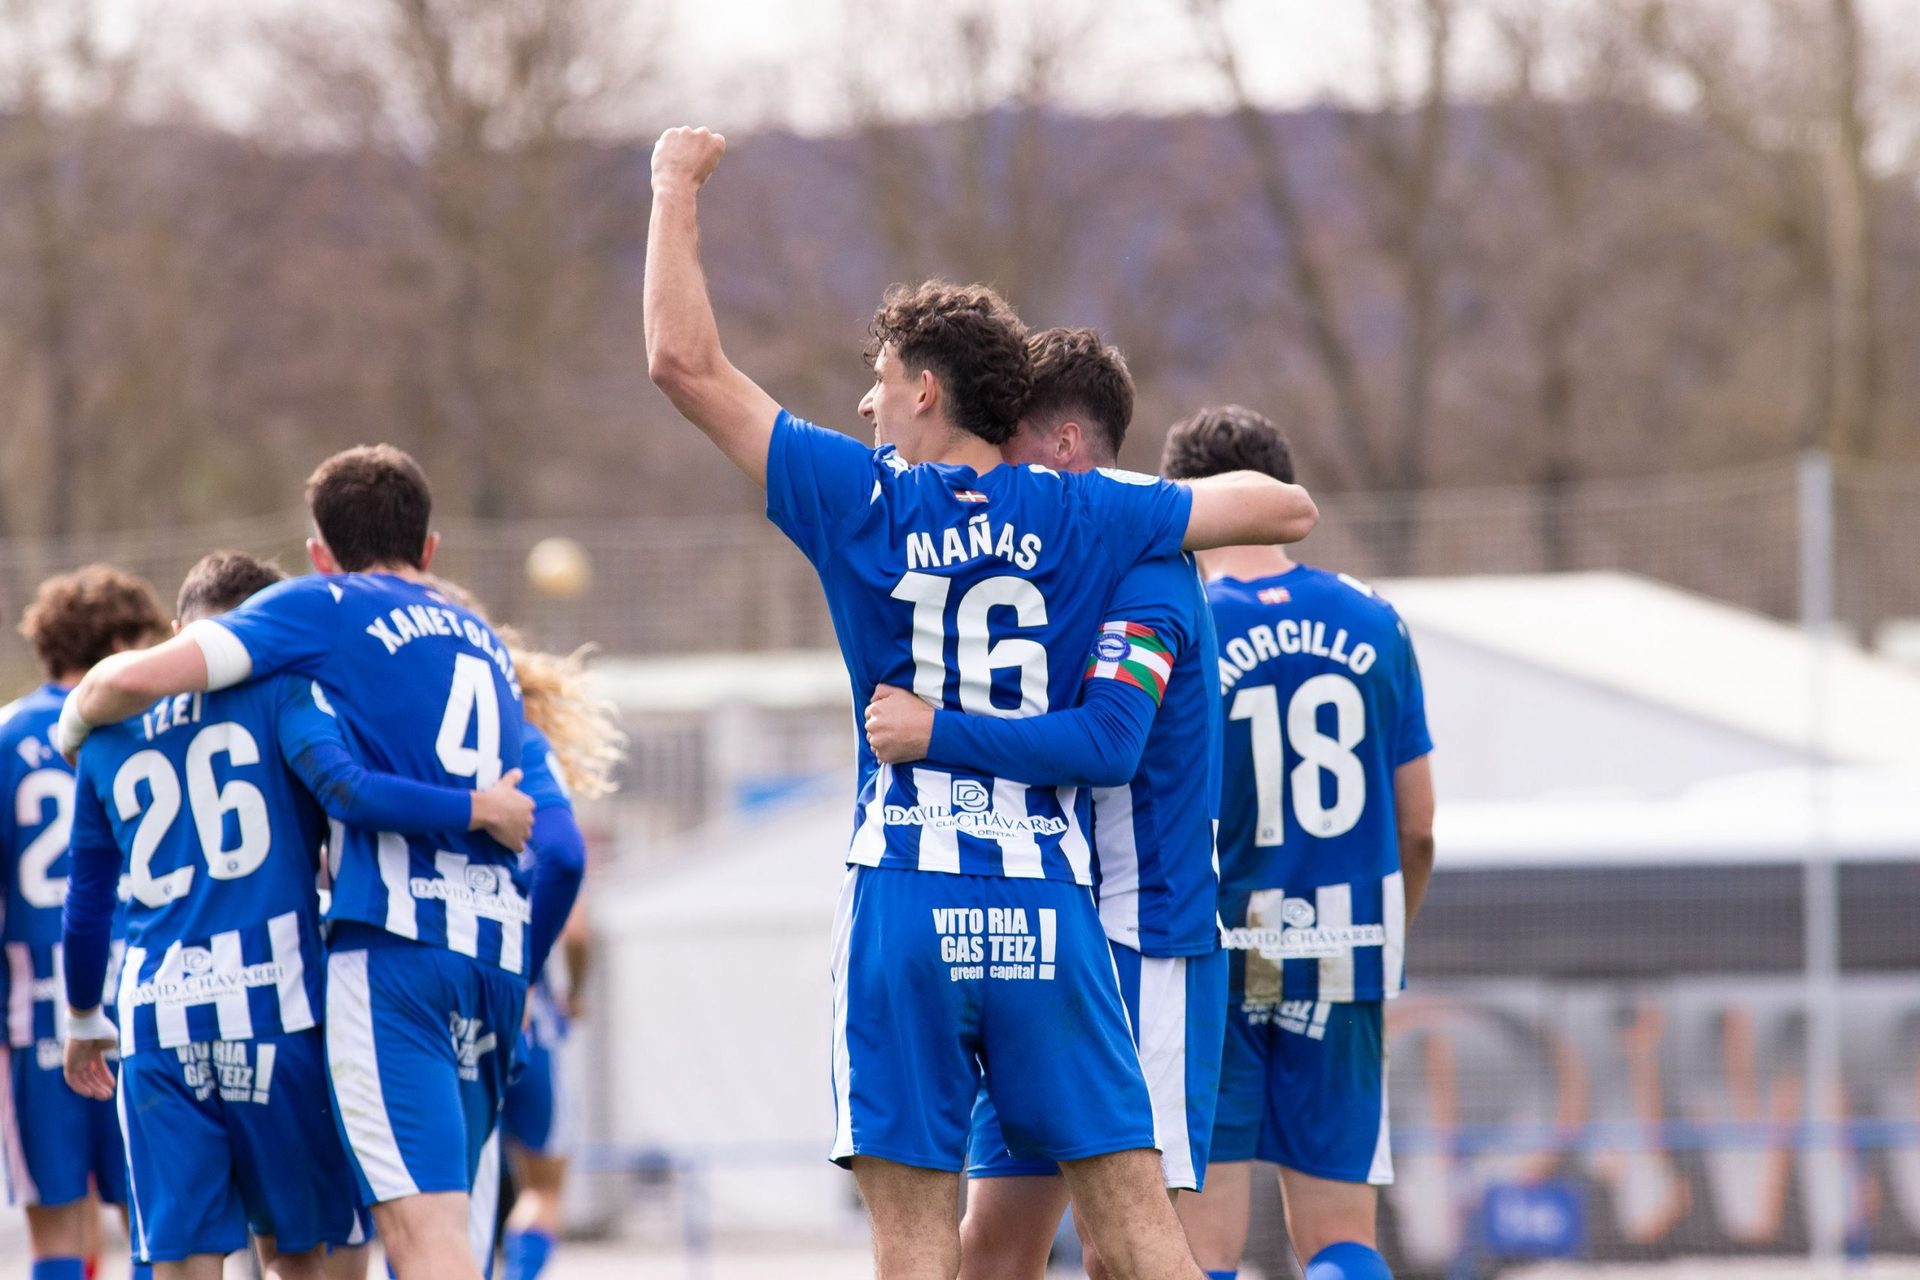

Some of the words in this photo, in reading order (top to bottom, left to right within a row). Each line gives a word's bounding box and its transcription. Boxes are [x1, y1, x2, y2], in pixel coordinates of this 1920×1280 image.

[906, 513, 1042, 570] MAÑAS
[890, 571, 1049, 719] 16
[435, 652, 503, 791] 4
[1229, 673, 1366, 848] 18
[113, 721, 271, 909] 26
[889, 804, 951, 823] DAVID
[950, 965, 984, 981] green
[989, 964, 1035, 980] capital
